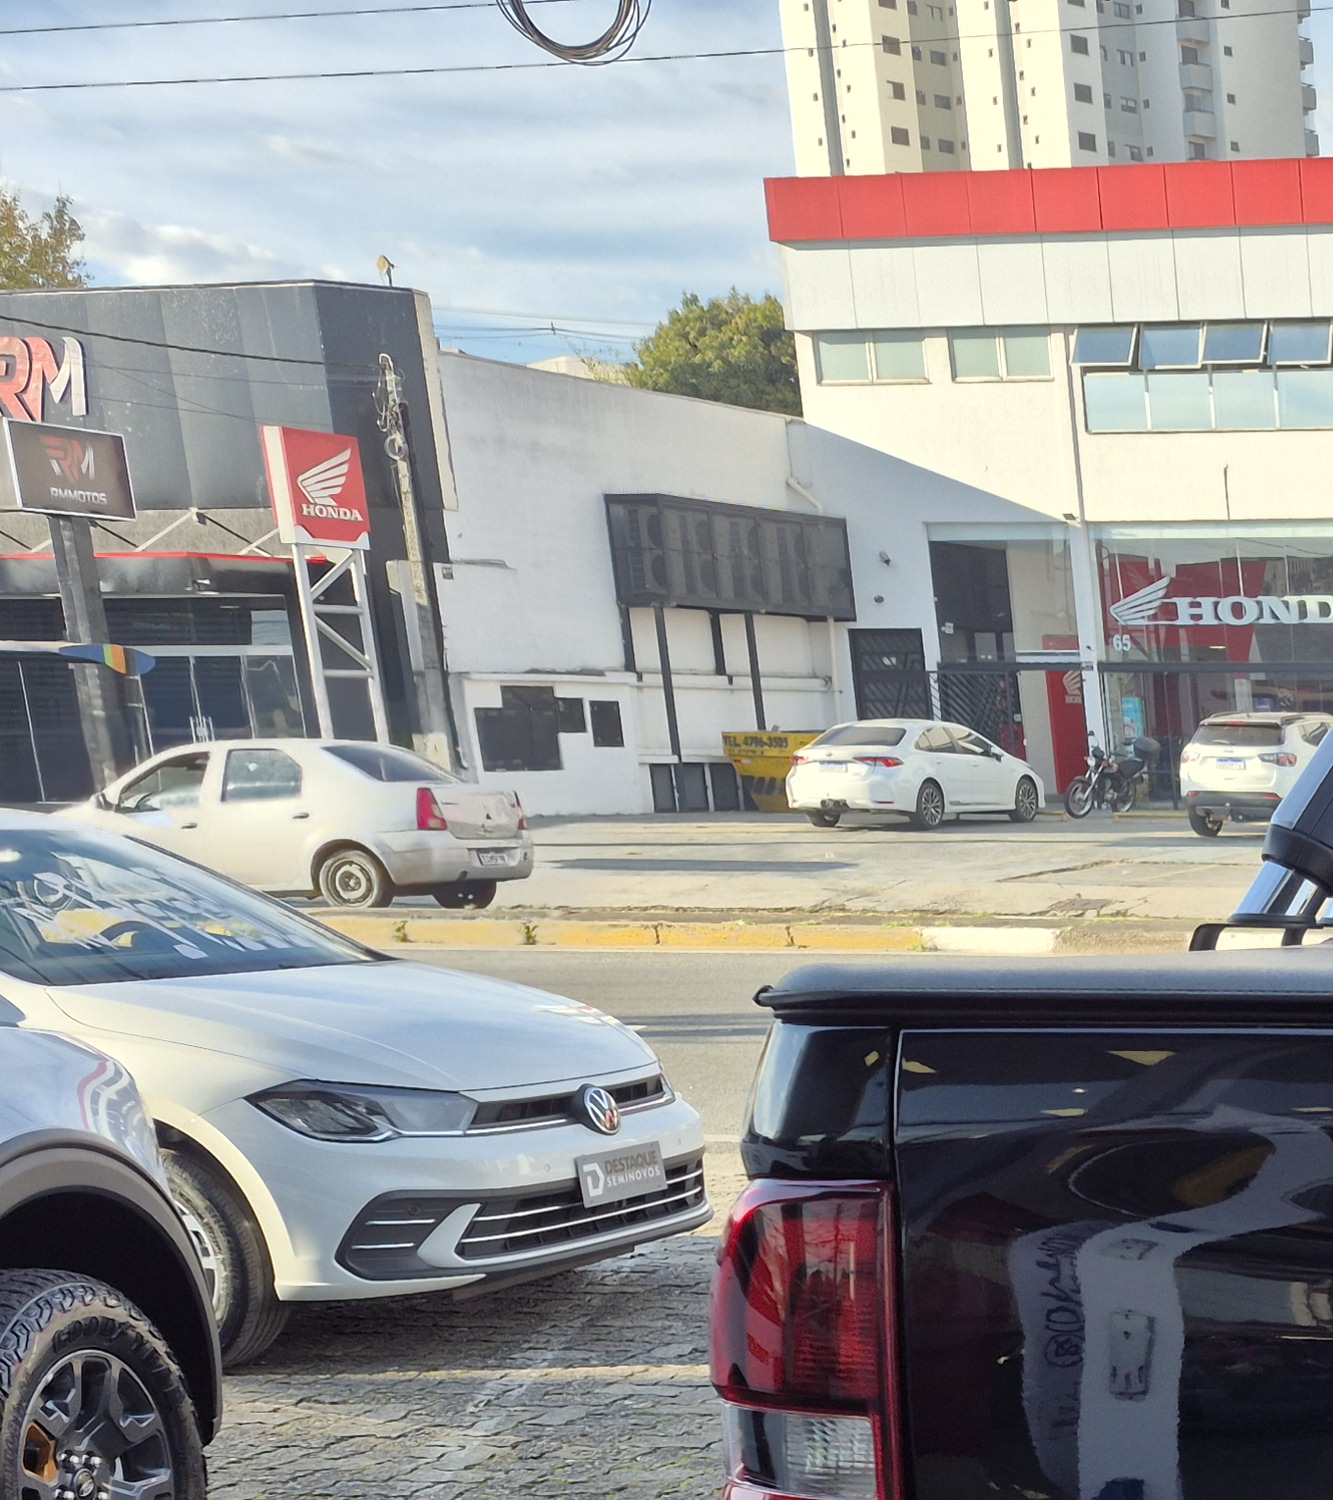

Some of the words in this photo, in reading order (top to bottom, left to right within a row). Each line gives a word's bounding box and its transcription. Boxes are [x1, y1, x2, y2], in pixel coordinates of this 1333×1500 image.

[302, 503, 364, 522] HONDA
[1112, 634, 1131, 651] 65
[605, 1150, 658, 1175] DESTAQUE
[607, 1166, 661, 1187] SEMINOVOS
